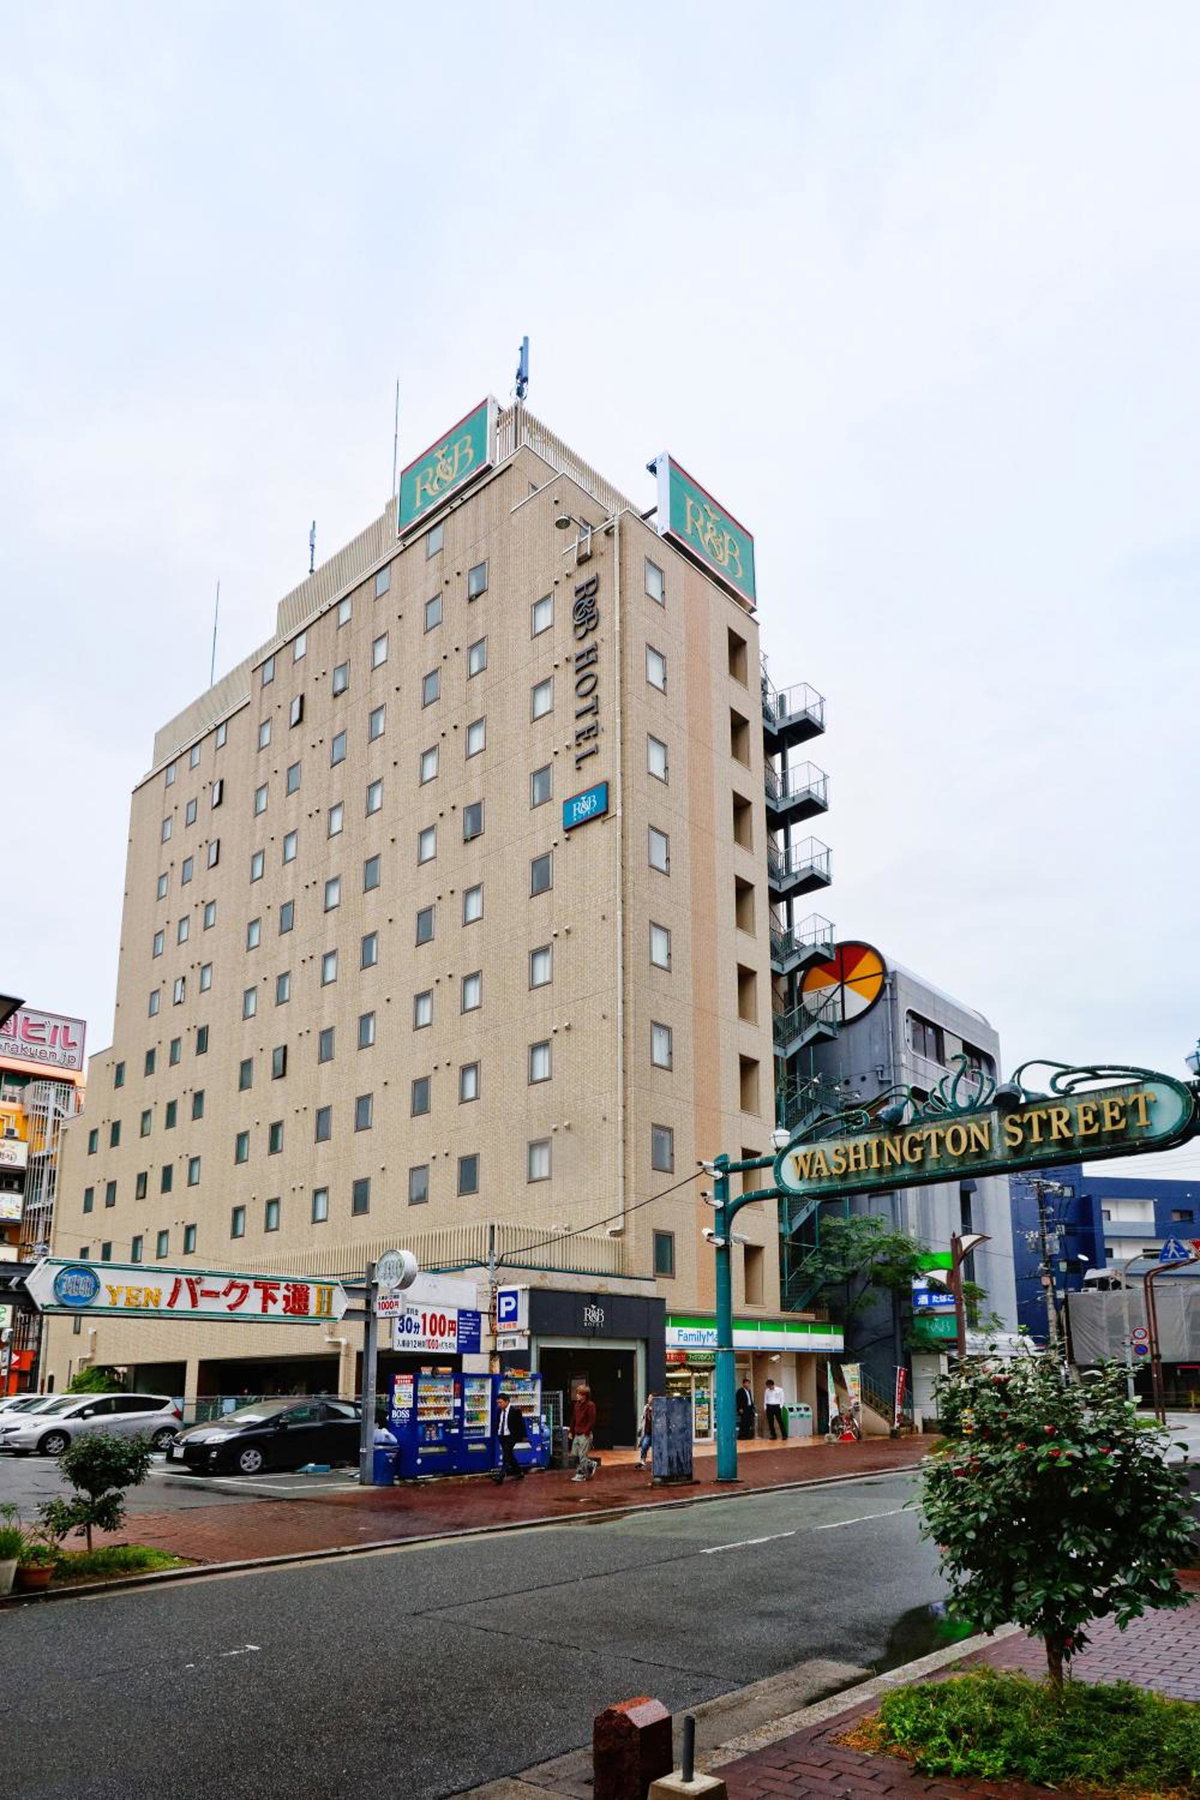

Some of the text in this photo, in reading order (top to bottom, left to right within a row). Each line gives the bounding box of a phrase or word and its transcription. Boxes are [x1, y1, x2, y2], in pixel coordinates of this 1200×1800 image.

[414, 435, 474, 511] R&B
[684, 494, 743, 579] R&B
[573, 572, 599, 770] R&B HOTEL
[572, 794, 597, 817] R&B
[0, 1042, 77, 1065] rakuen.jp
[790, 1092, 1157, 1180] WASHINGTON STREET
[105, 1285, 162, 1307] YEN
[500, 1296, 516, 1318] P
[421, 1312, 457, 1337] 100円
[583, 1304, 605, 1323] R&B
[391, 1409, 410, 1419] BOSS
